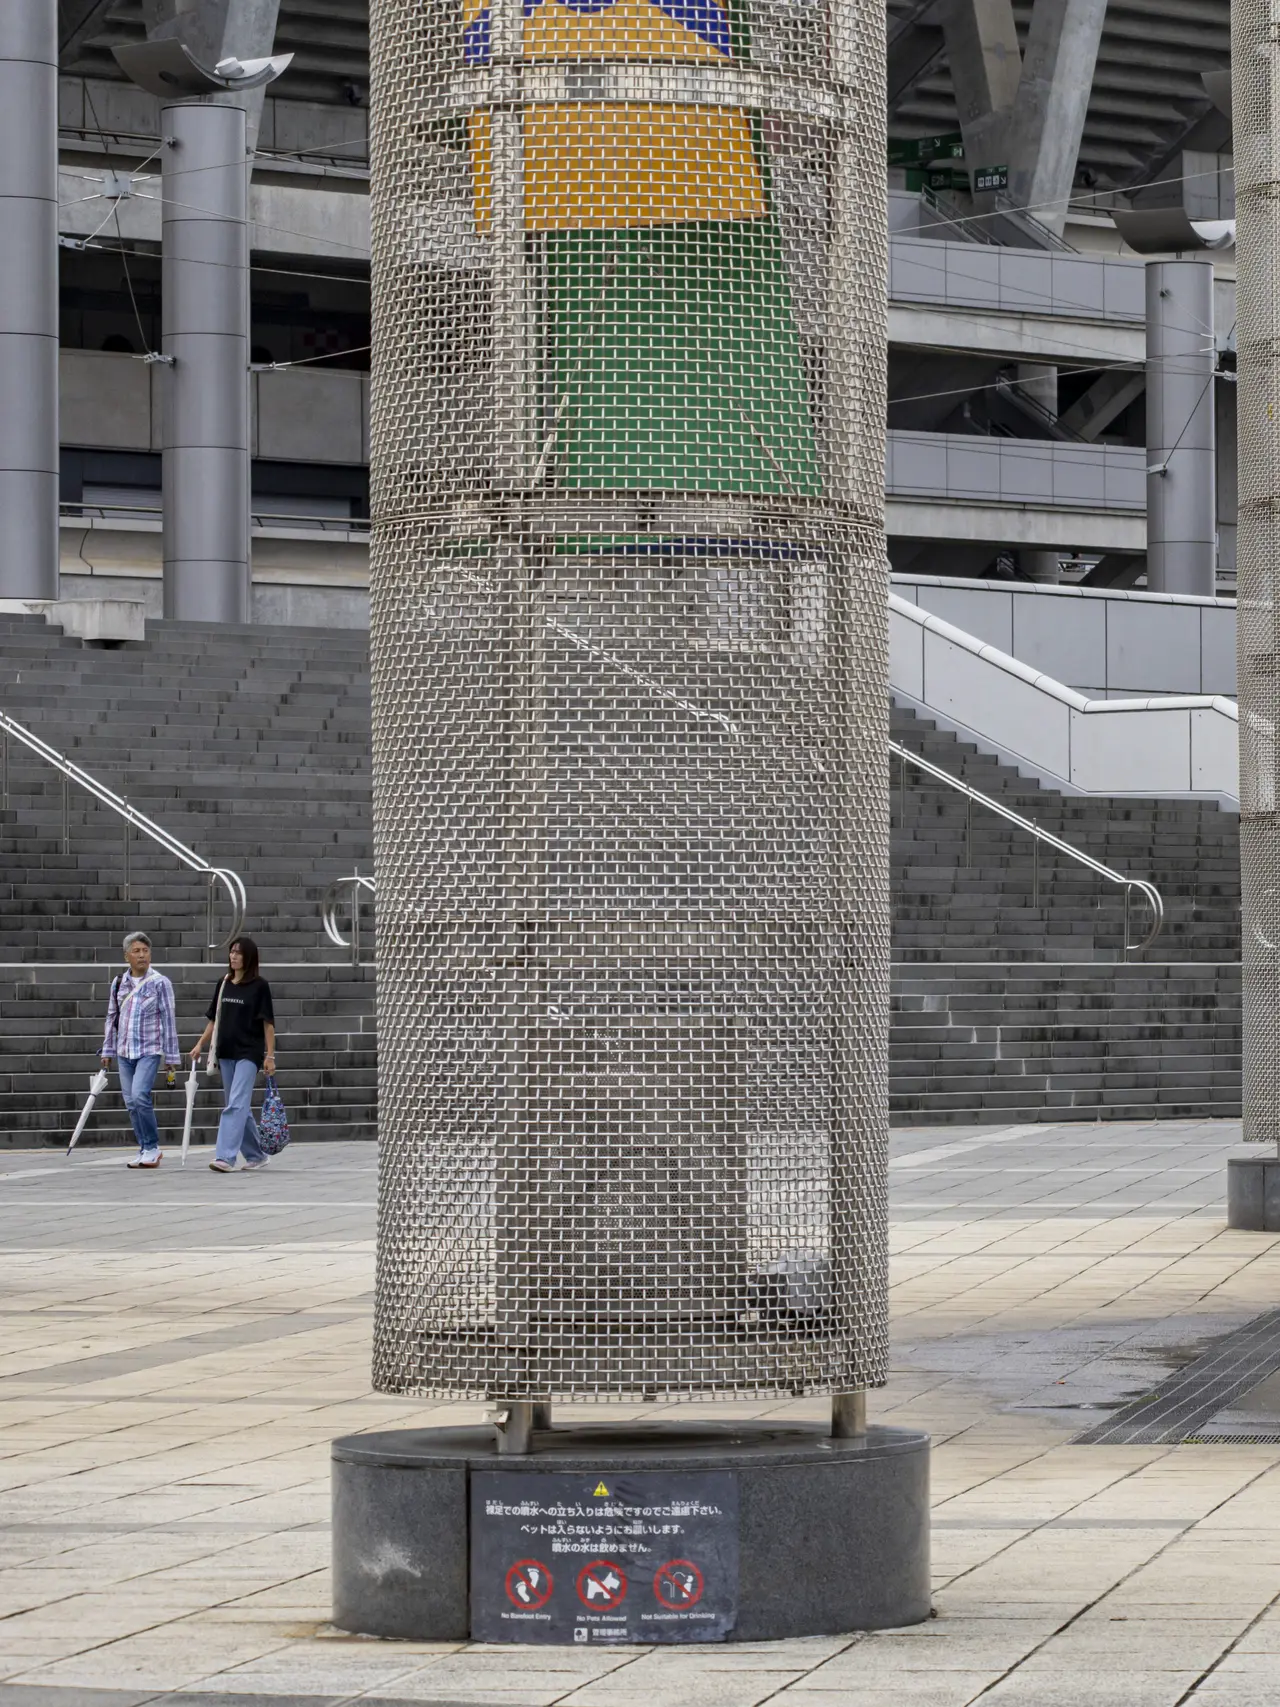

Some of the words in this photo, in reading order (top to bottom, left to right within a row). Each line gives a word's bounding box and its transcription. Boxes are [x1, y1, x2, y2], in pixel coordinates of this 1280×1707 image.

[552, 1542, 652, 1553] 噴水の水は飲めません。
[535, 1613, 552, 1621] Entry
[689, 1611, 716, 1620] Drinking
